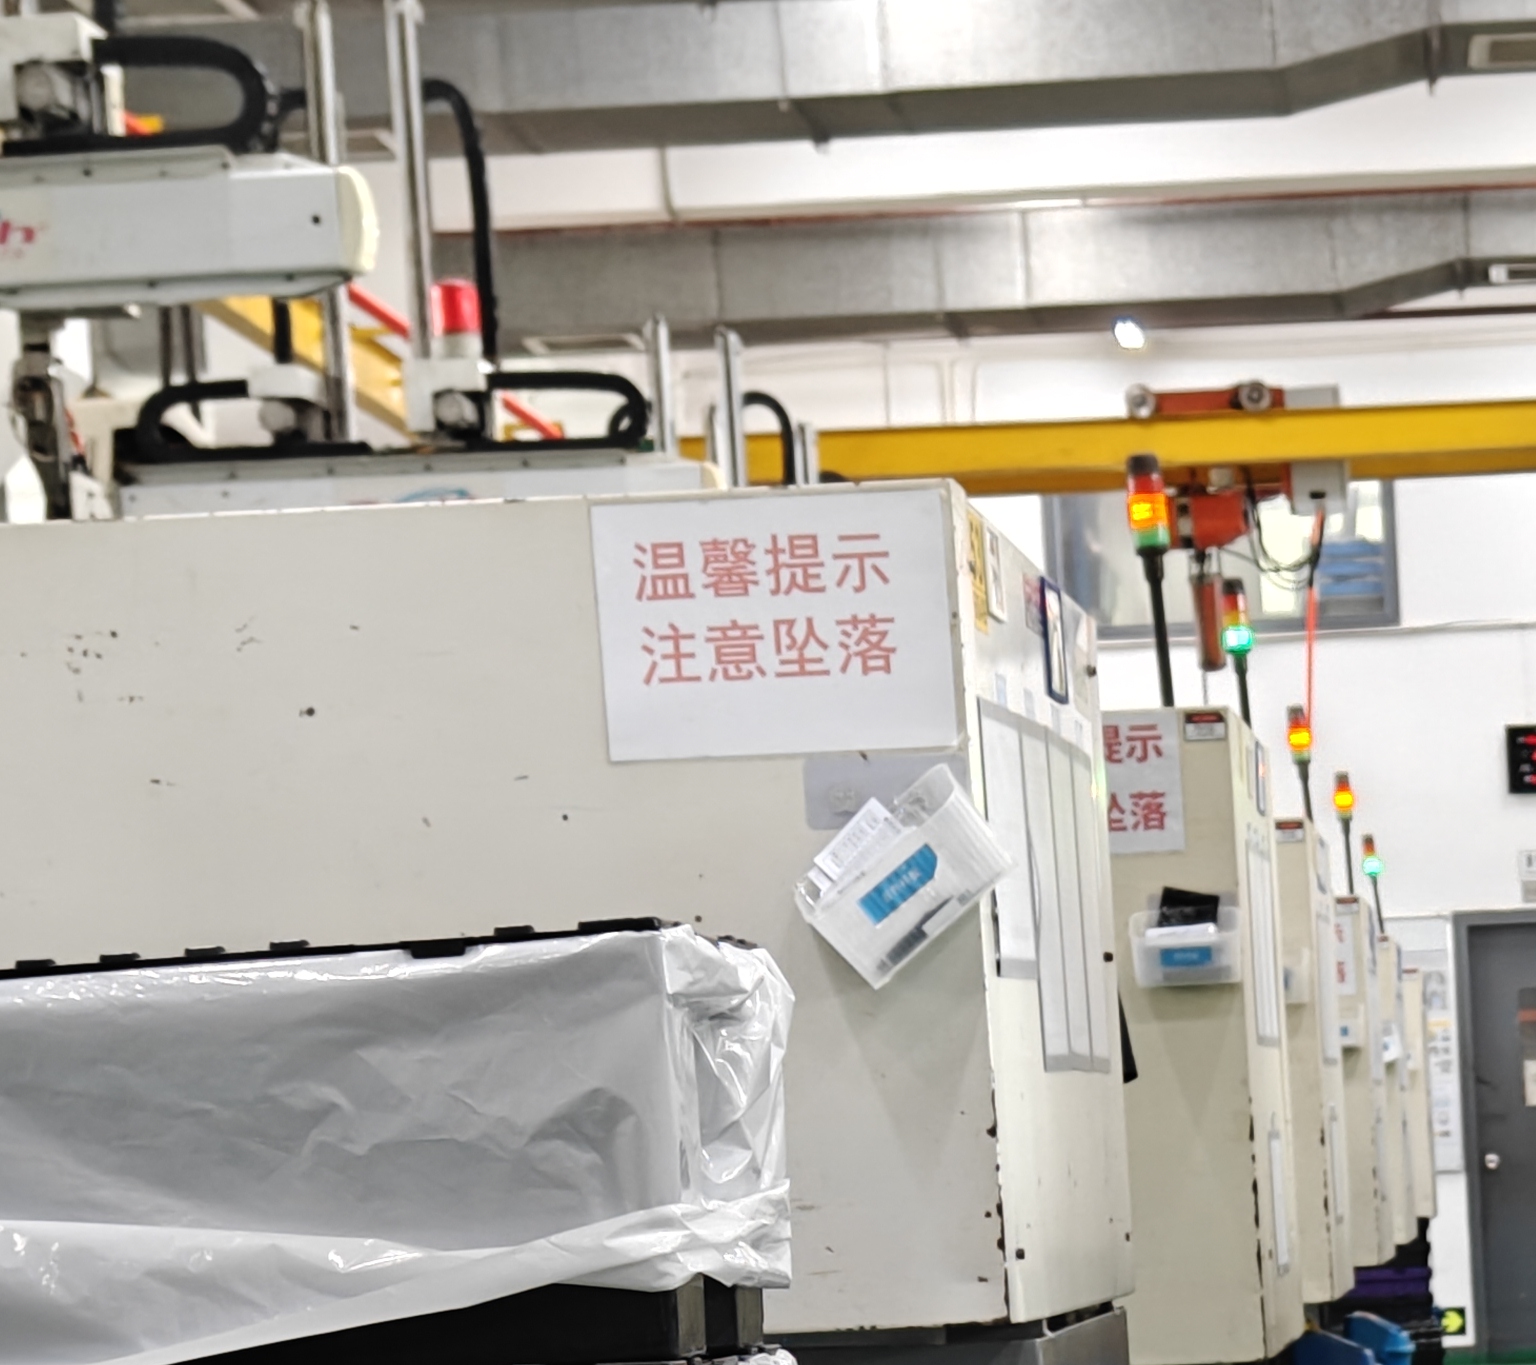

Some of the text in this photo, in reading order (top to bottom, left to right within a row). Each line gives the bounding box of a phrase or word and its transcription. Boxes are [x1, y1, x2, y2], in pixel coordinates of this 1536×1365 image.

[633, 533, 890, 602] 温馨提示
[640, 613, 897, 686] 注意坠落
